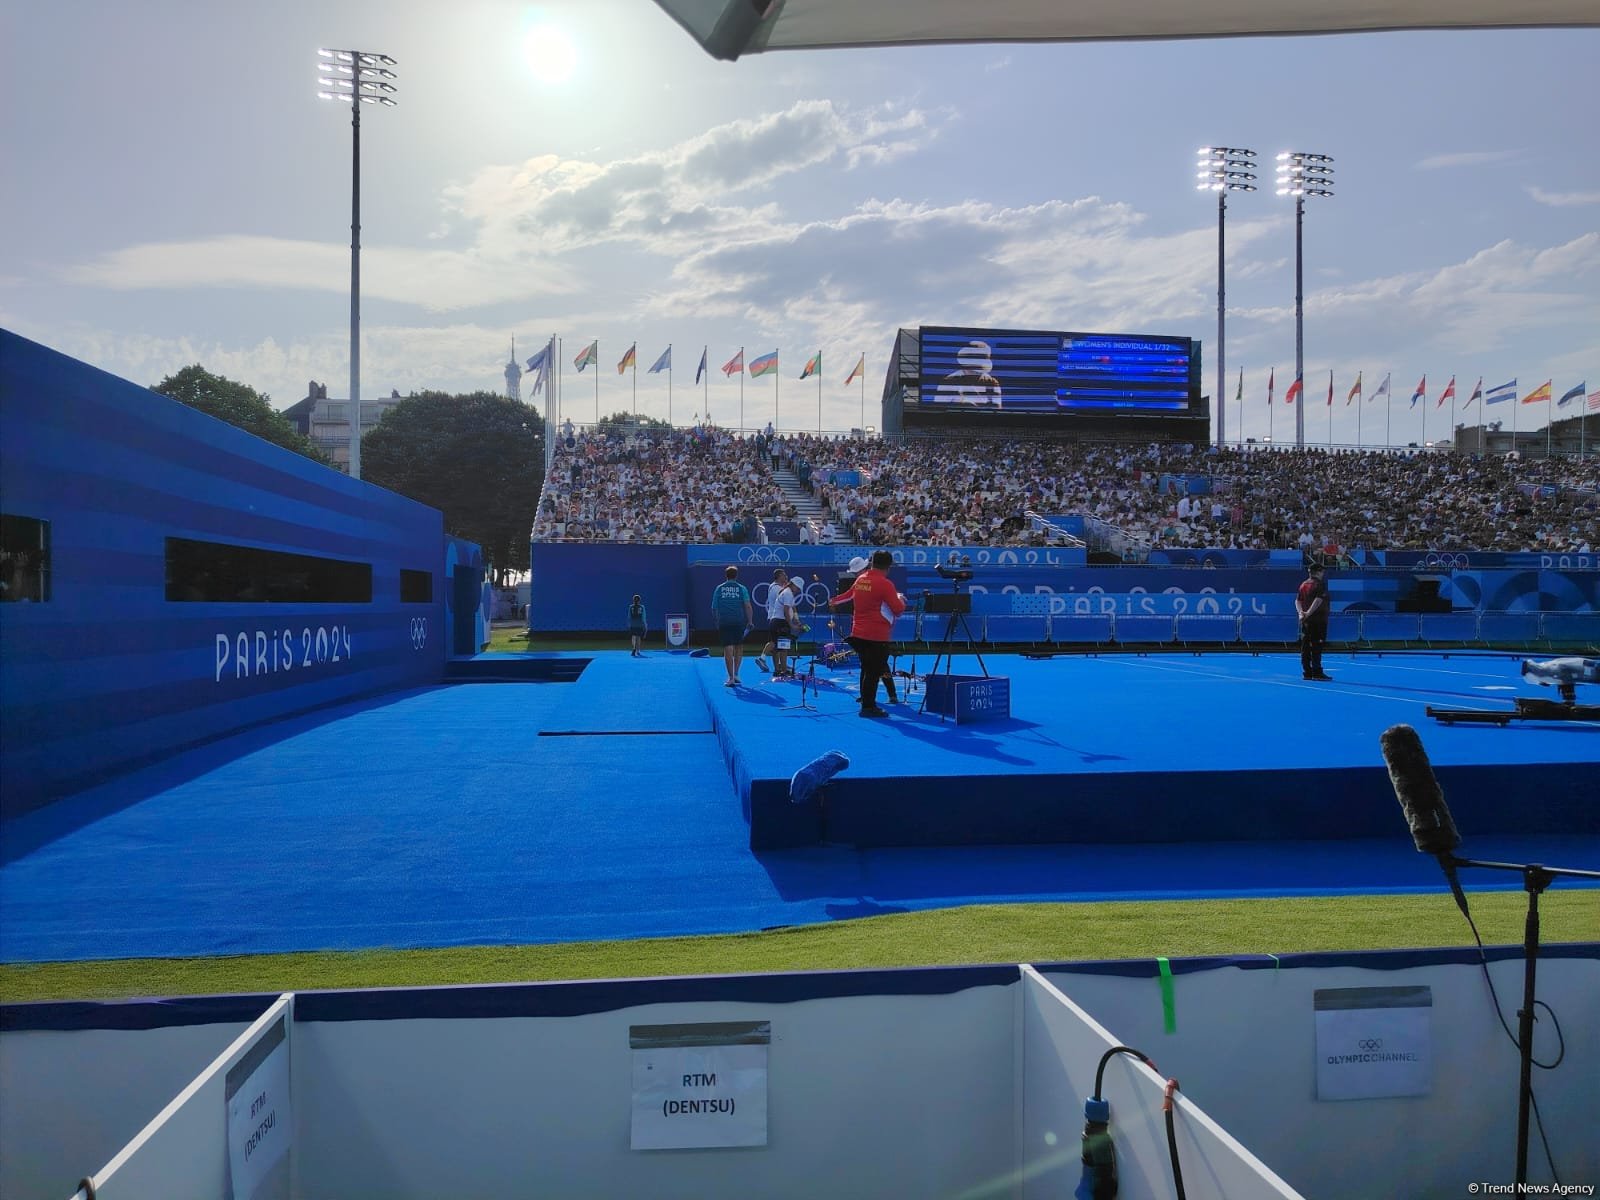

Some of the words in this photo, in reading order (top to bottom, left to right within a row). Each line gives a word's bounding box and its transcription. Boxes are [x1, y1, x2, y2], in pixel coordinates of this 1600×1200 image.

[1113, 342, 1153, 350] INDIVIDUAL
[1154, 343, 1170, 351] 1/32
[977, 550, 1059, 564] 2024
[1173, 597, 1266, 614] 2024
[302, 625, 351, 667] 2024
[970, 697, 992, 710] 2024
[682, 1073, 716, 1087] RTM
[251, 1091, 266, 1119] RTM
[663, 1098, 735, 1117] (DENTSU)
[244, 1110, 276, 1162] (DENTSU)
